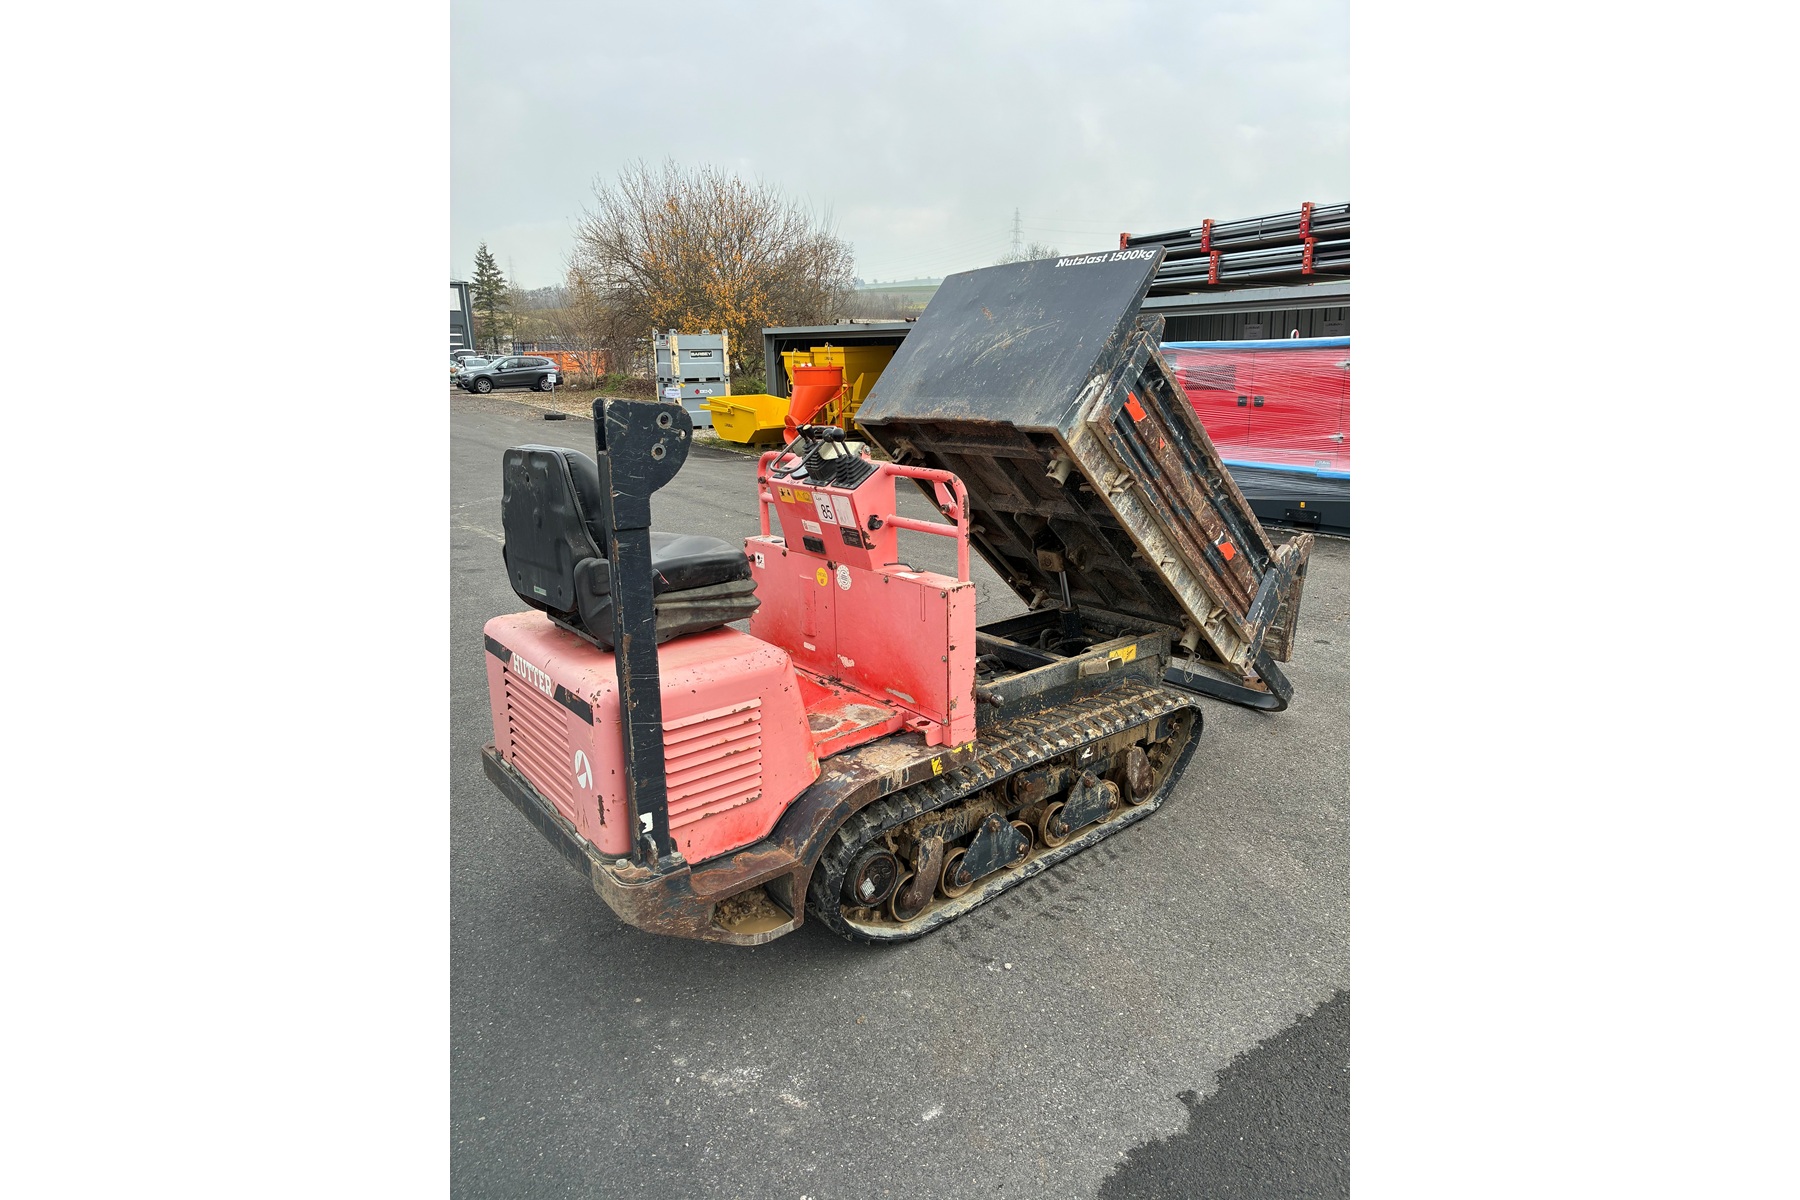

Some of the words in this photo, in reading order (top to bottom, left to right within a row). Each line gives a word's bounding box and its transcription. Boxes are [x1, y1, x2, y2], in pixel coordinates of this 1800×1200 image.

[1055, 253, 1108, 268] Nutzlast
[1108, 249, 1156, 261] 1500kg
[820, 504, 833, 520] 85
[512, 651, 553, 698] HUTTER
